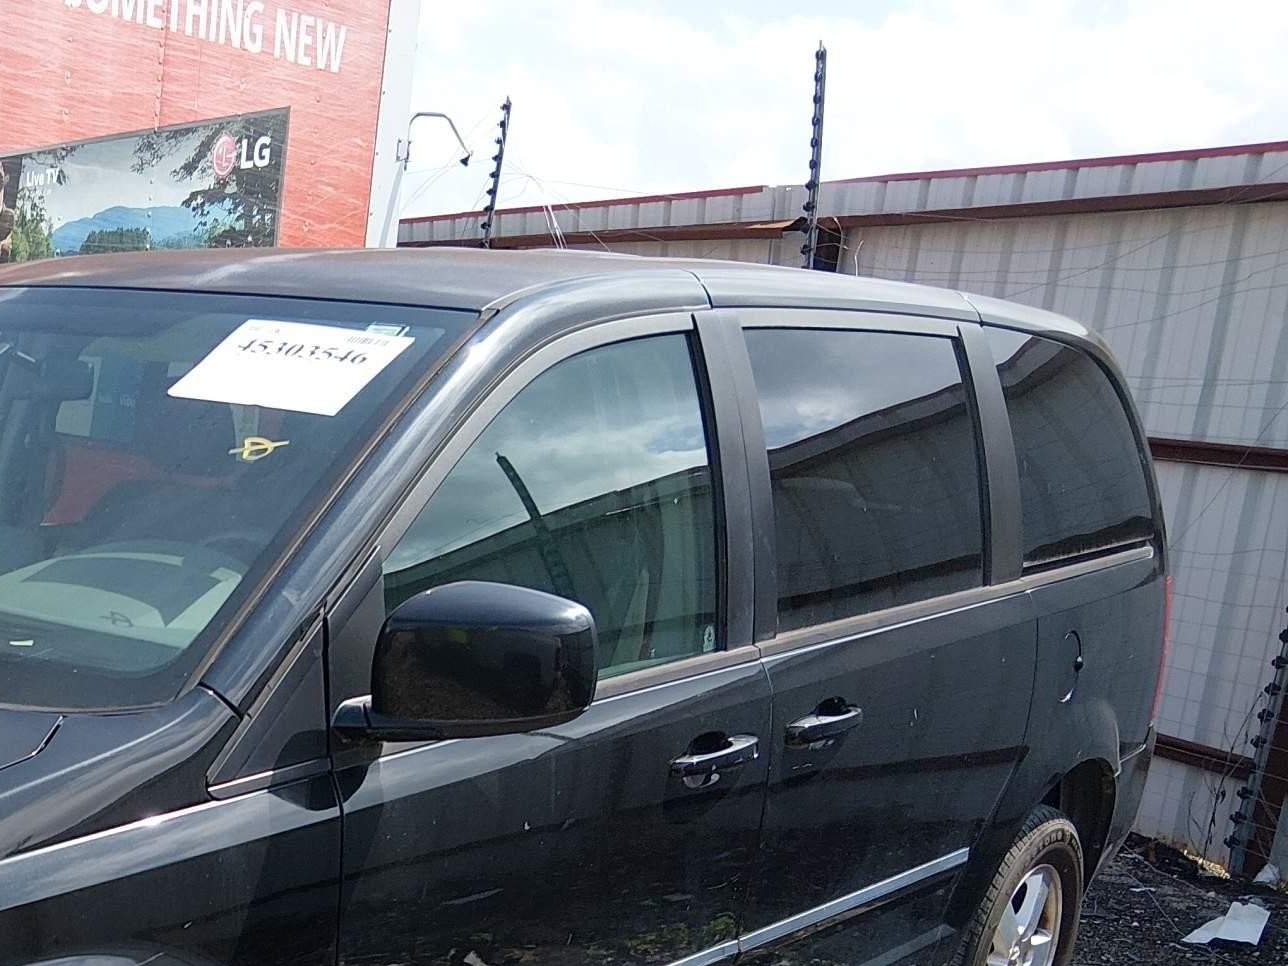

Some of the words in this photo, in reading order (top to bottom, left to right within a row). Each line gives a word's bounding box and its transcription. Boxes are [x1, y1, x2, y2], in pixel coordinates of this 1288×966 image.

[274, 8, 347, 74] NEW
[240, 136, 272, 169] LG
[46, 167, 60, 185] TV
[238, 339, 368, 364] 45303546
